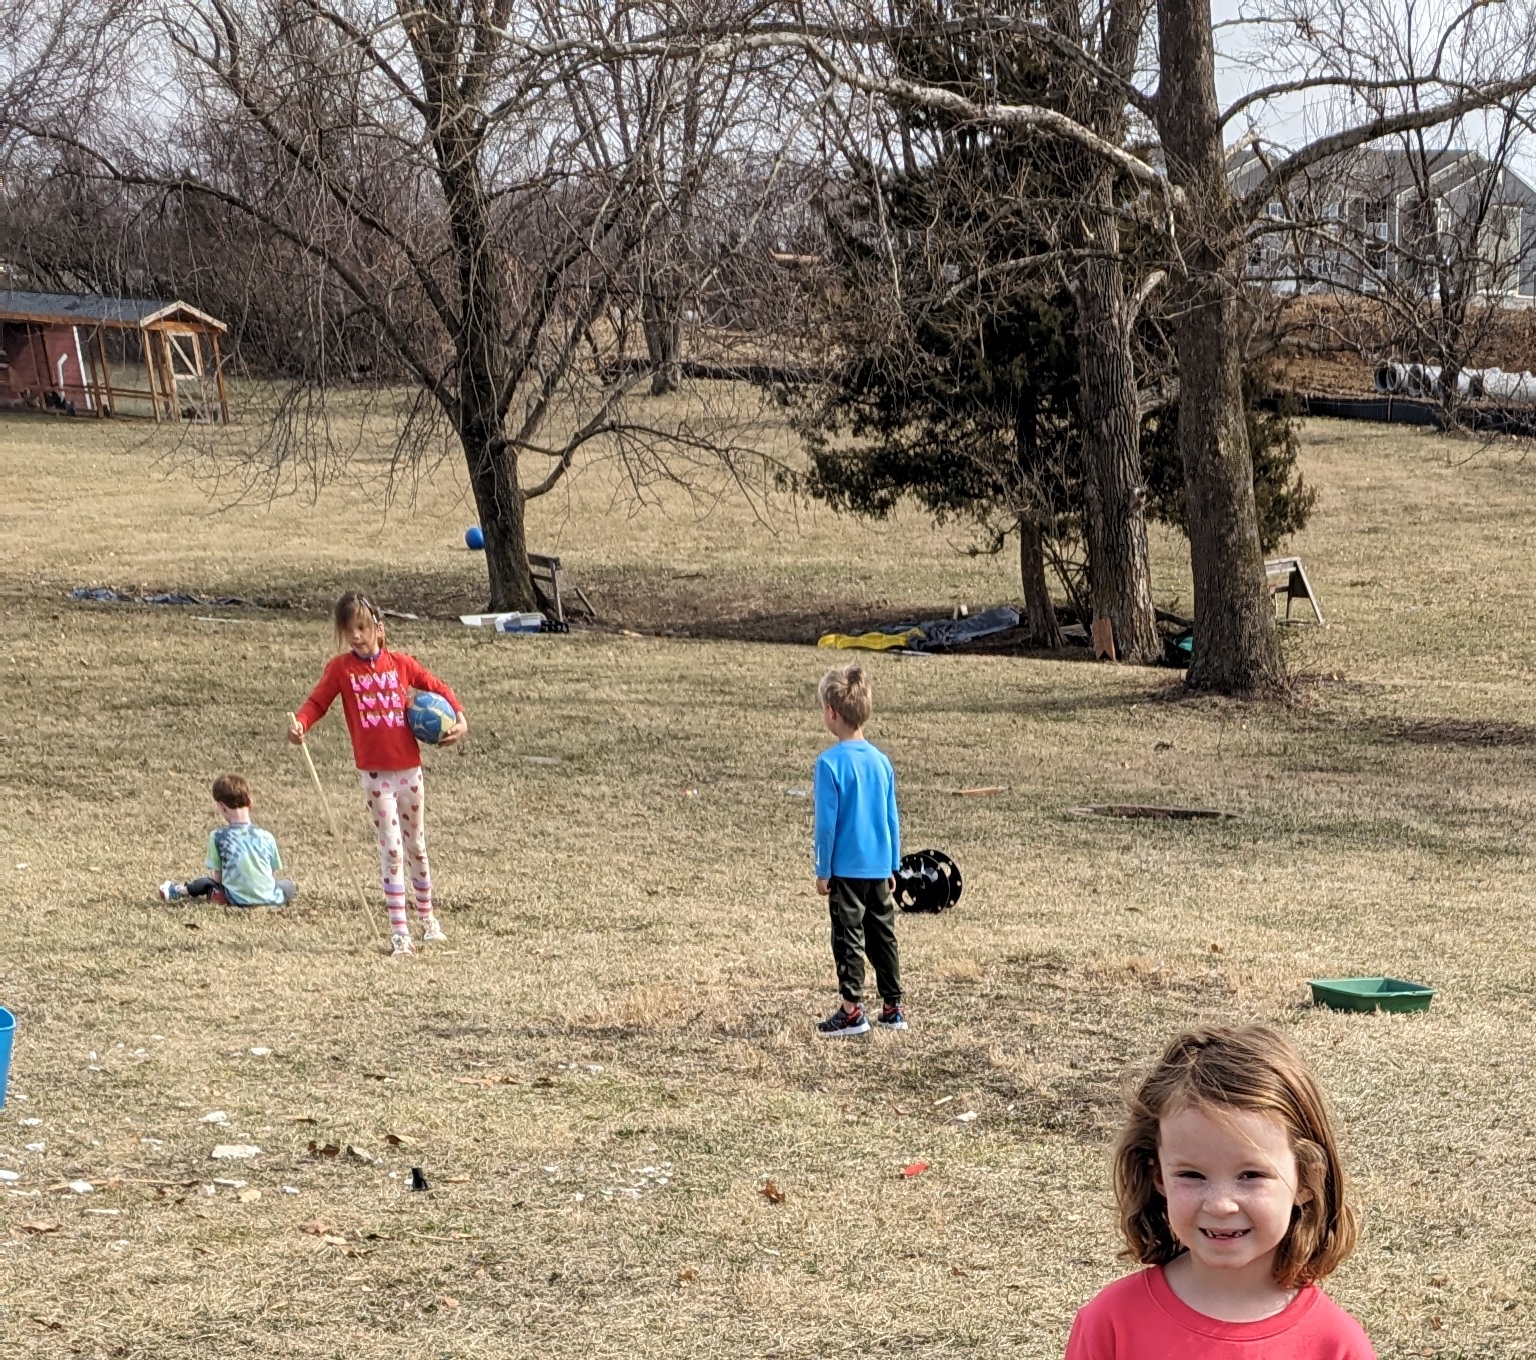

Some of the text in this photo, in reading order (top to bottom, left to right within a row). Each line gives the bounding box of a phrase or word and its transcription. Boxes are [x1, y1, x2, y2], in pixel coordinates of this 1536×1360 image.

[350, 669, 399, 691] LOVE
[354, 691, 402, 710] LOVE
[360, 709, 405, 728] LOVE
